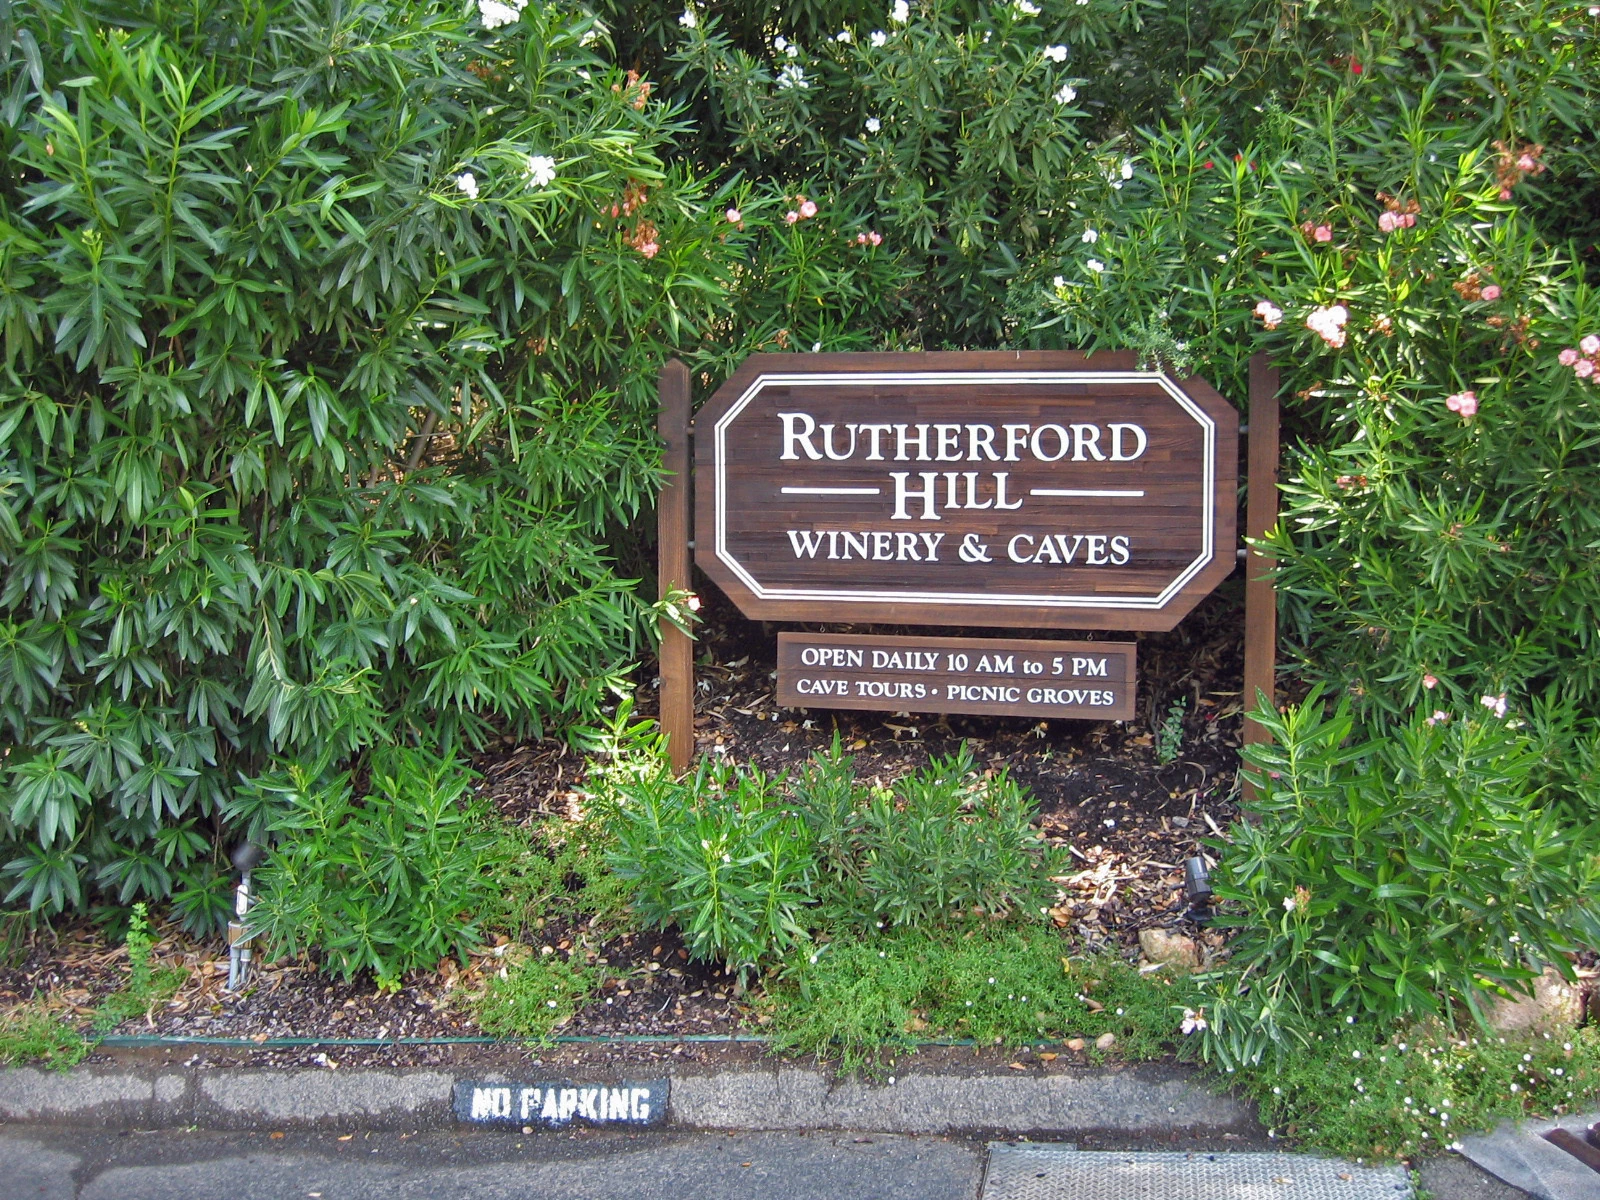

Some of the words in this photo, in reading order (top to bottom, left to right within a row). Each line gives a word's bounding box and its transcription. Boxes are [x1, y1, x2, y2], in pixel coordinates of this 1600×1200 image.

[777, 412, 1147, 462] RUTHERFORD
[889, 471, 1023, 521] HILL
[786, 529, 946, 562] WINERY
[958, 533, 993, 563] &
[1007, 534, 1130, 565] CAVES
[801, 647, 864, 668] OPEN
[871, 650, 940, 671] DAILY
[946, 653, 969, 672] 10
[975, 654, 1015, 674] AM
[1022, 659, 1044, 675] to
[1050, 657, 1066, 676] 5
[1072, 657, 1108, 678] PM
[796, 679, 849, 696] CAVE
[855, 681, 927, 699] TOURS
[946, 685, 1020, 703] PICNIC
[1027, 688, 1115, 706] GROVES
[470, 1087, 512, 1120] NO
[519, 1087, 651, 1121] PARKING
